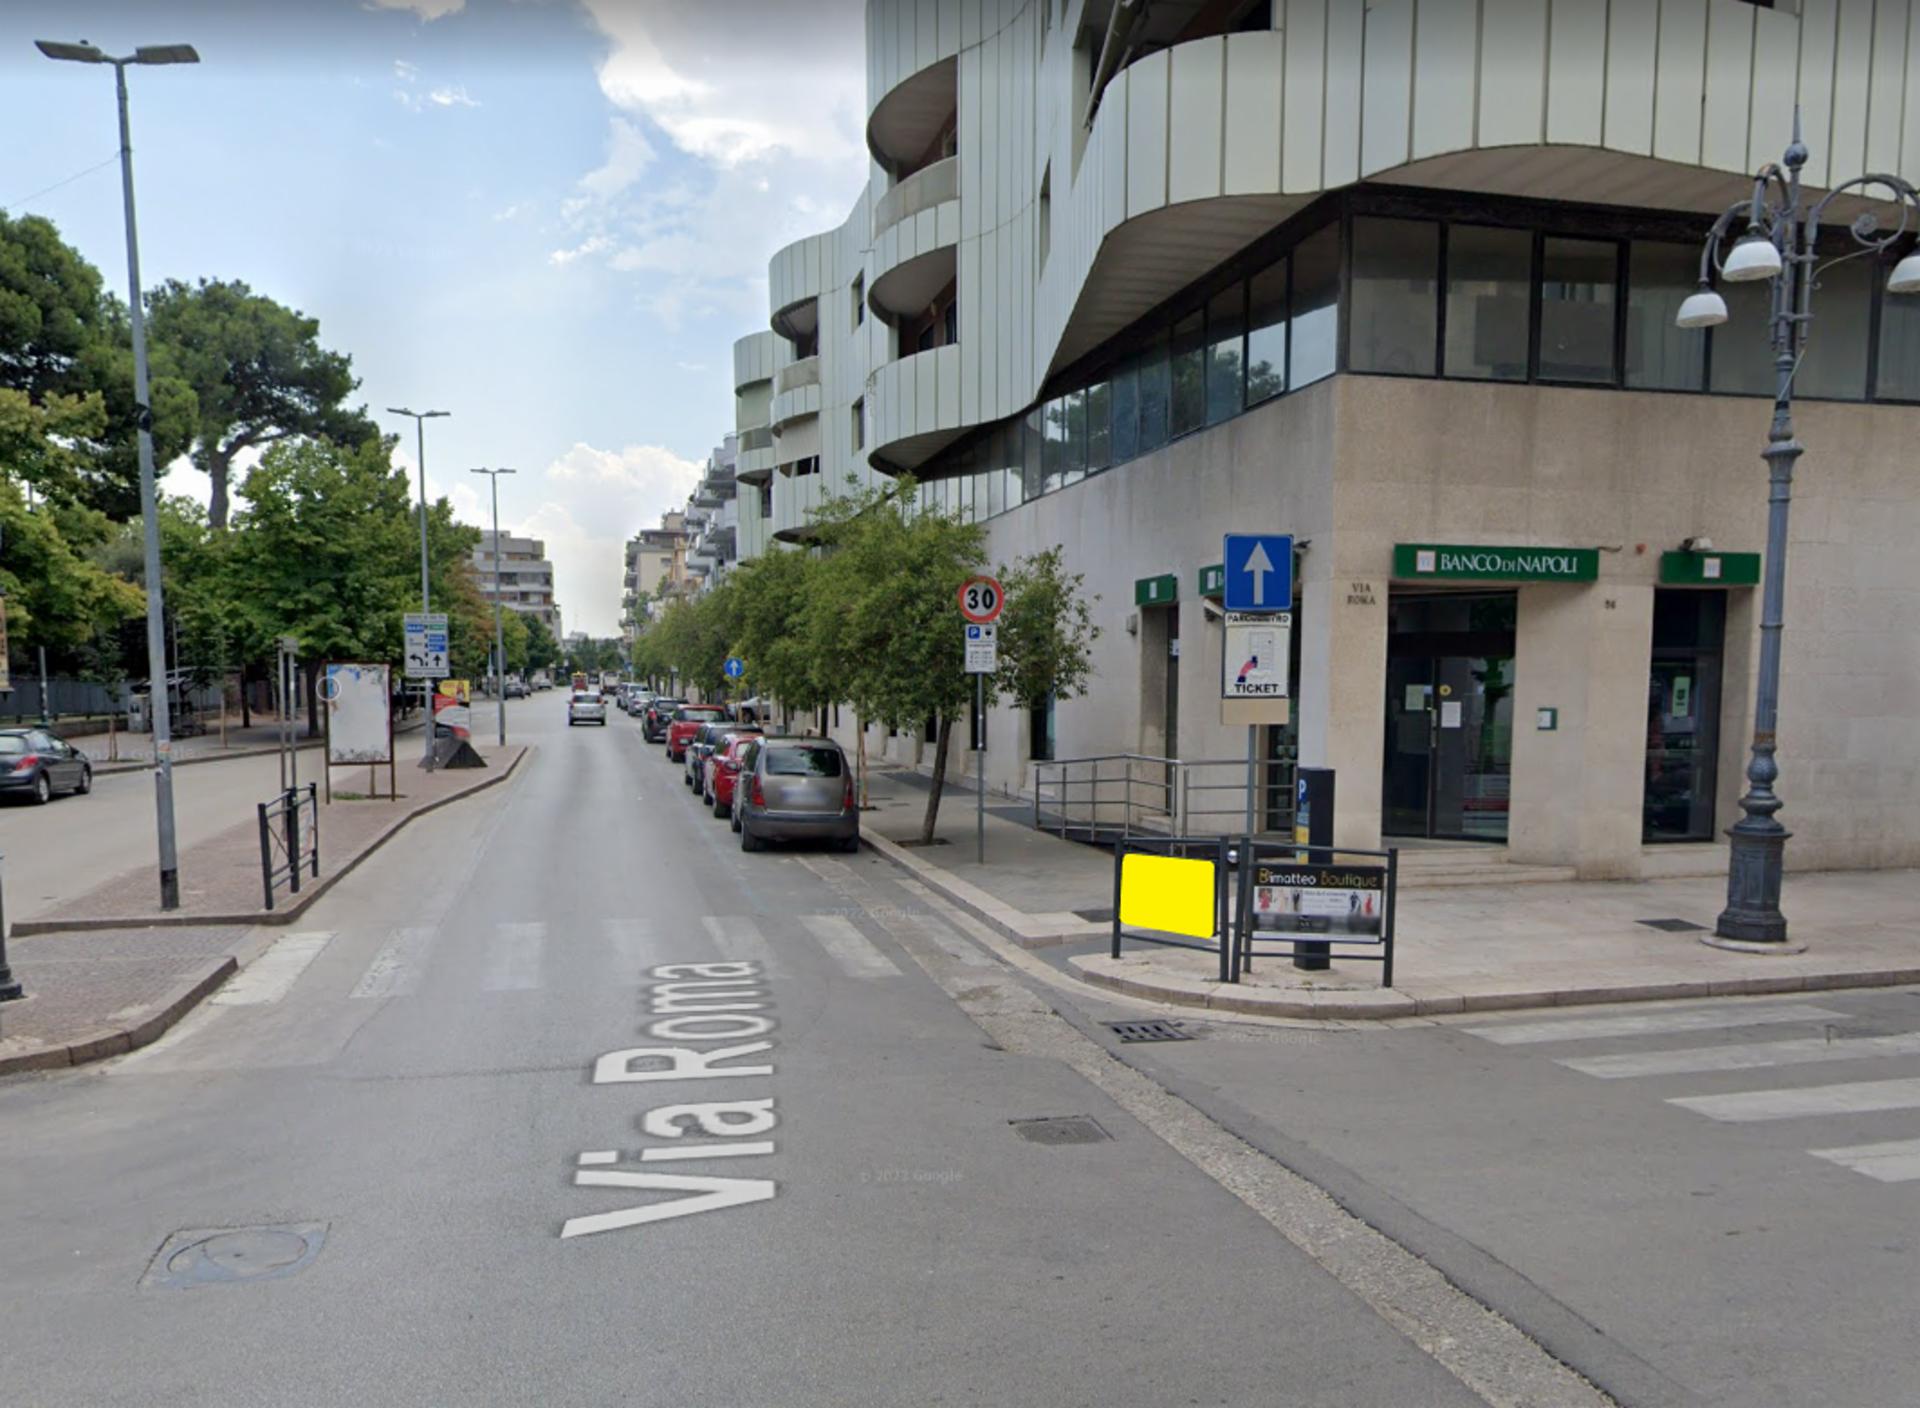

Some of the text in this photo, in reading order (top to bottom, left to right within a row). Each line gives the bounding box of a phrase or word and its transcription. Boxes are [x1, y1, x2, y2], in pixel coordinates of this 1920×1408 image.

[1440, 553, 1500, 571] BANCO
[1517, 556, 1577, 573] NAPOLI
[1352, 583, 1371, 593] VIA
[967, 588, 994, 610] 30
[1228, 614, 1289, 623] PARCTRO
[1234, 683, 1279, 694] TICKET
[1298, 779, 1307, 800] P
